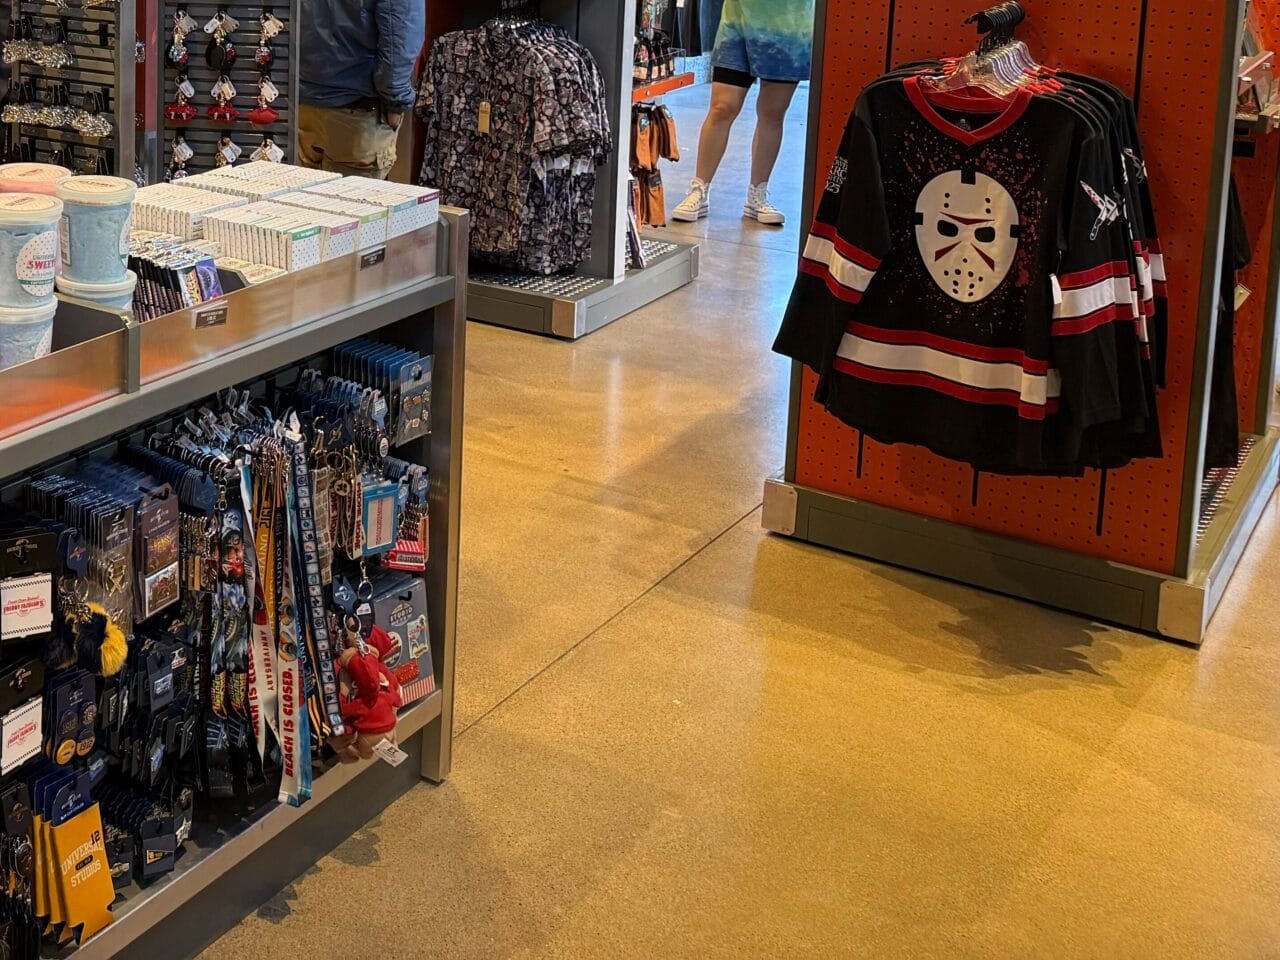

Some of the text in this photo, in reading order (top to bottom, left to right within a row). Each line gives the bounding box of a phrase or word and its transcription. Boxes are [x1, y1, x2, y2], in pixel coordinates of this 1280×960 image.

[25, 259, 56, 270] SWEET
[389, 606, 414, 623] STUDIO
[260, 630, 275, 692] ANNIVERSARY
[282, 667, 295, 778] BEACH IS CLOSED.
[91, 830, 101, 845] 12
[61, 840, 104, 875] UNIVERSAL
[71, 859, 102, 887] STUDIOS
